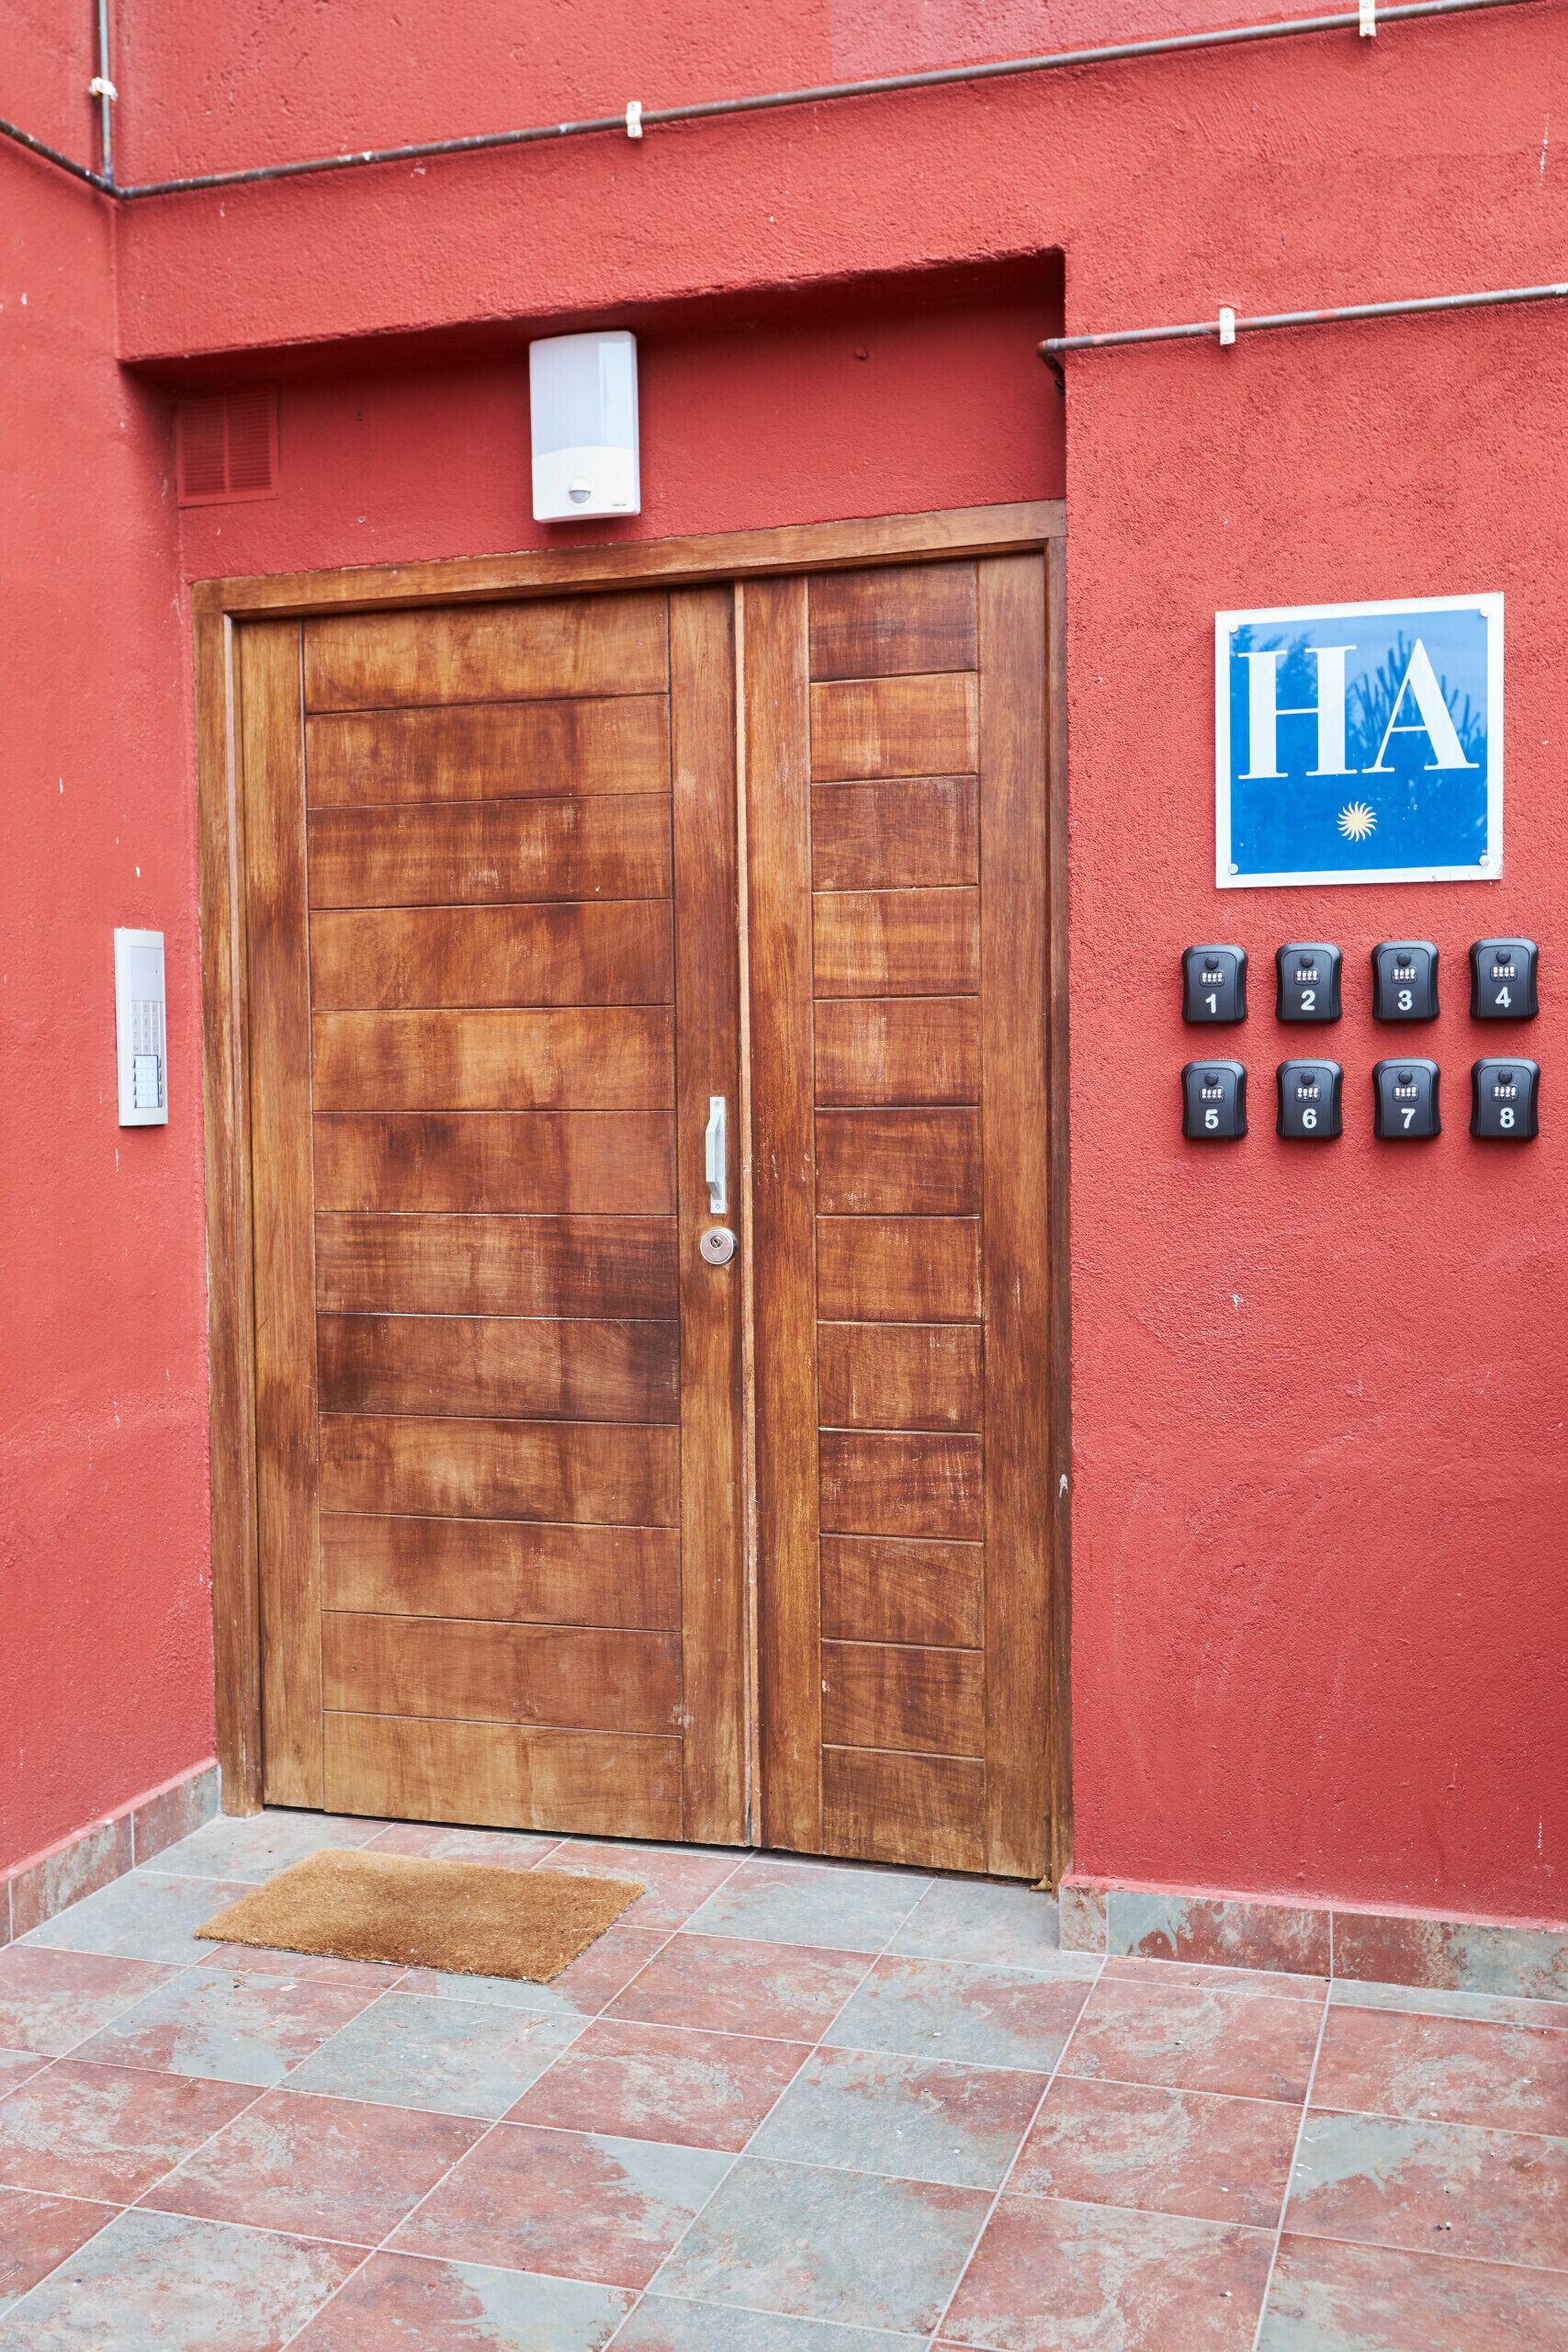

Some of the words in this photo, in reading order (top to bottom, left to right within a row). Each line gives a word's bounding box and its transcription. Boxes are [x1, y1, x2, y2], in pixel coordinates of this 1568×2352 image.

[1237, 638, 1480, 779] HA
[1205, 993, 1217, 1014] 1
[1301, 989, 1315, 1011] 2
[1397, 989, 1412, 1011] 3
[1495, 987, 1511, 1008] 4
[1204, 1109, 1218, 1129] 5
[1302, 1108, 1316, 1129] 6
[1401, 1108, 1416, 1129] 7
[1499, 1107, 1515, 1128] 8
